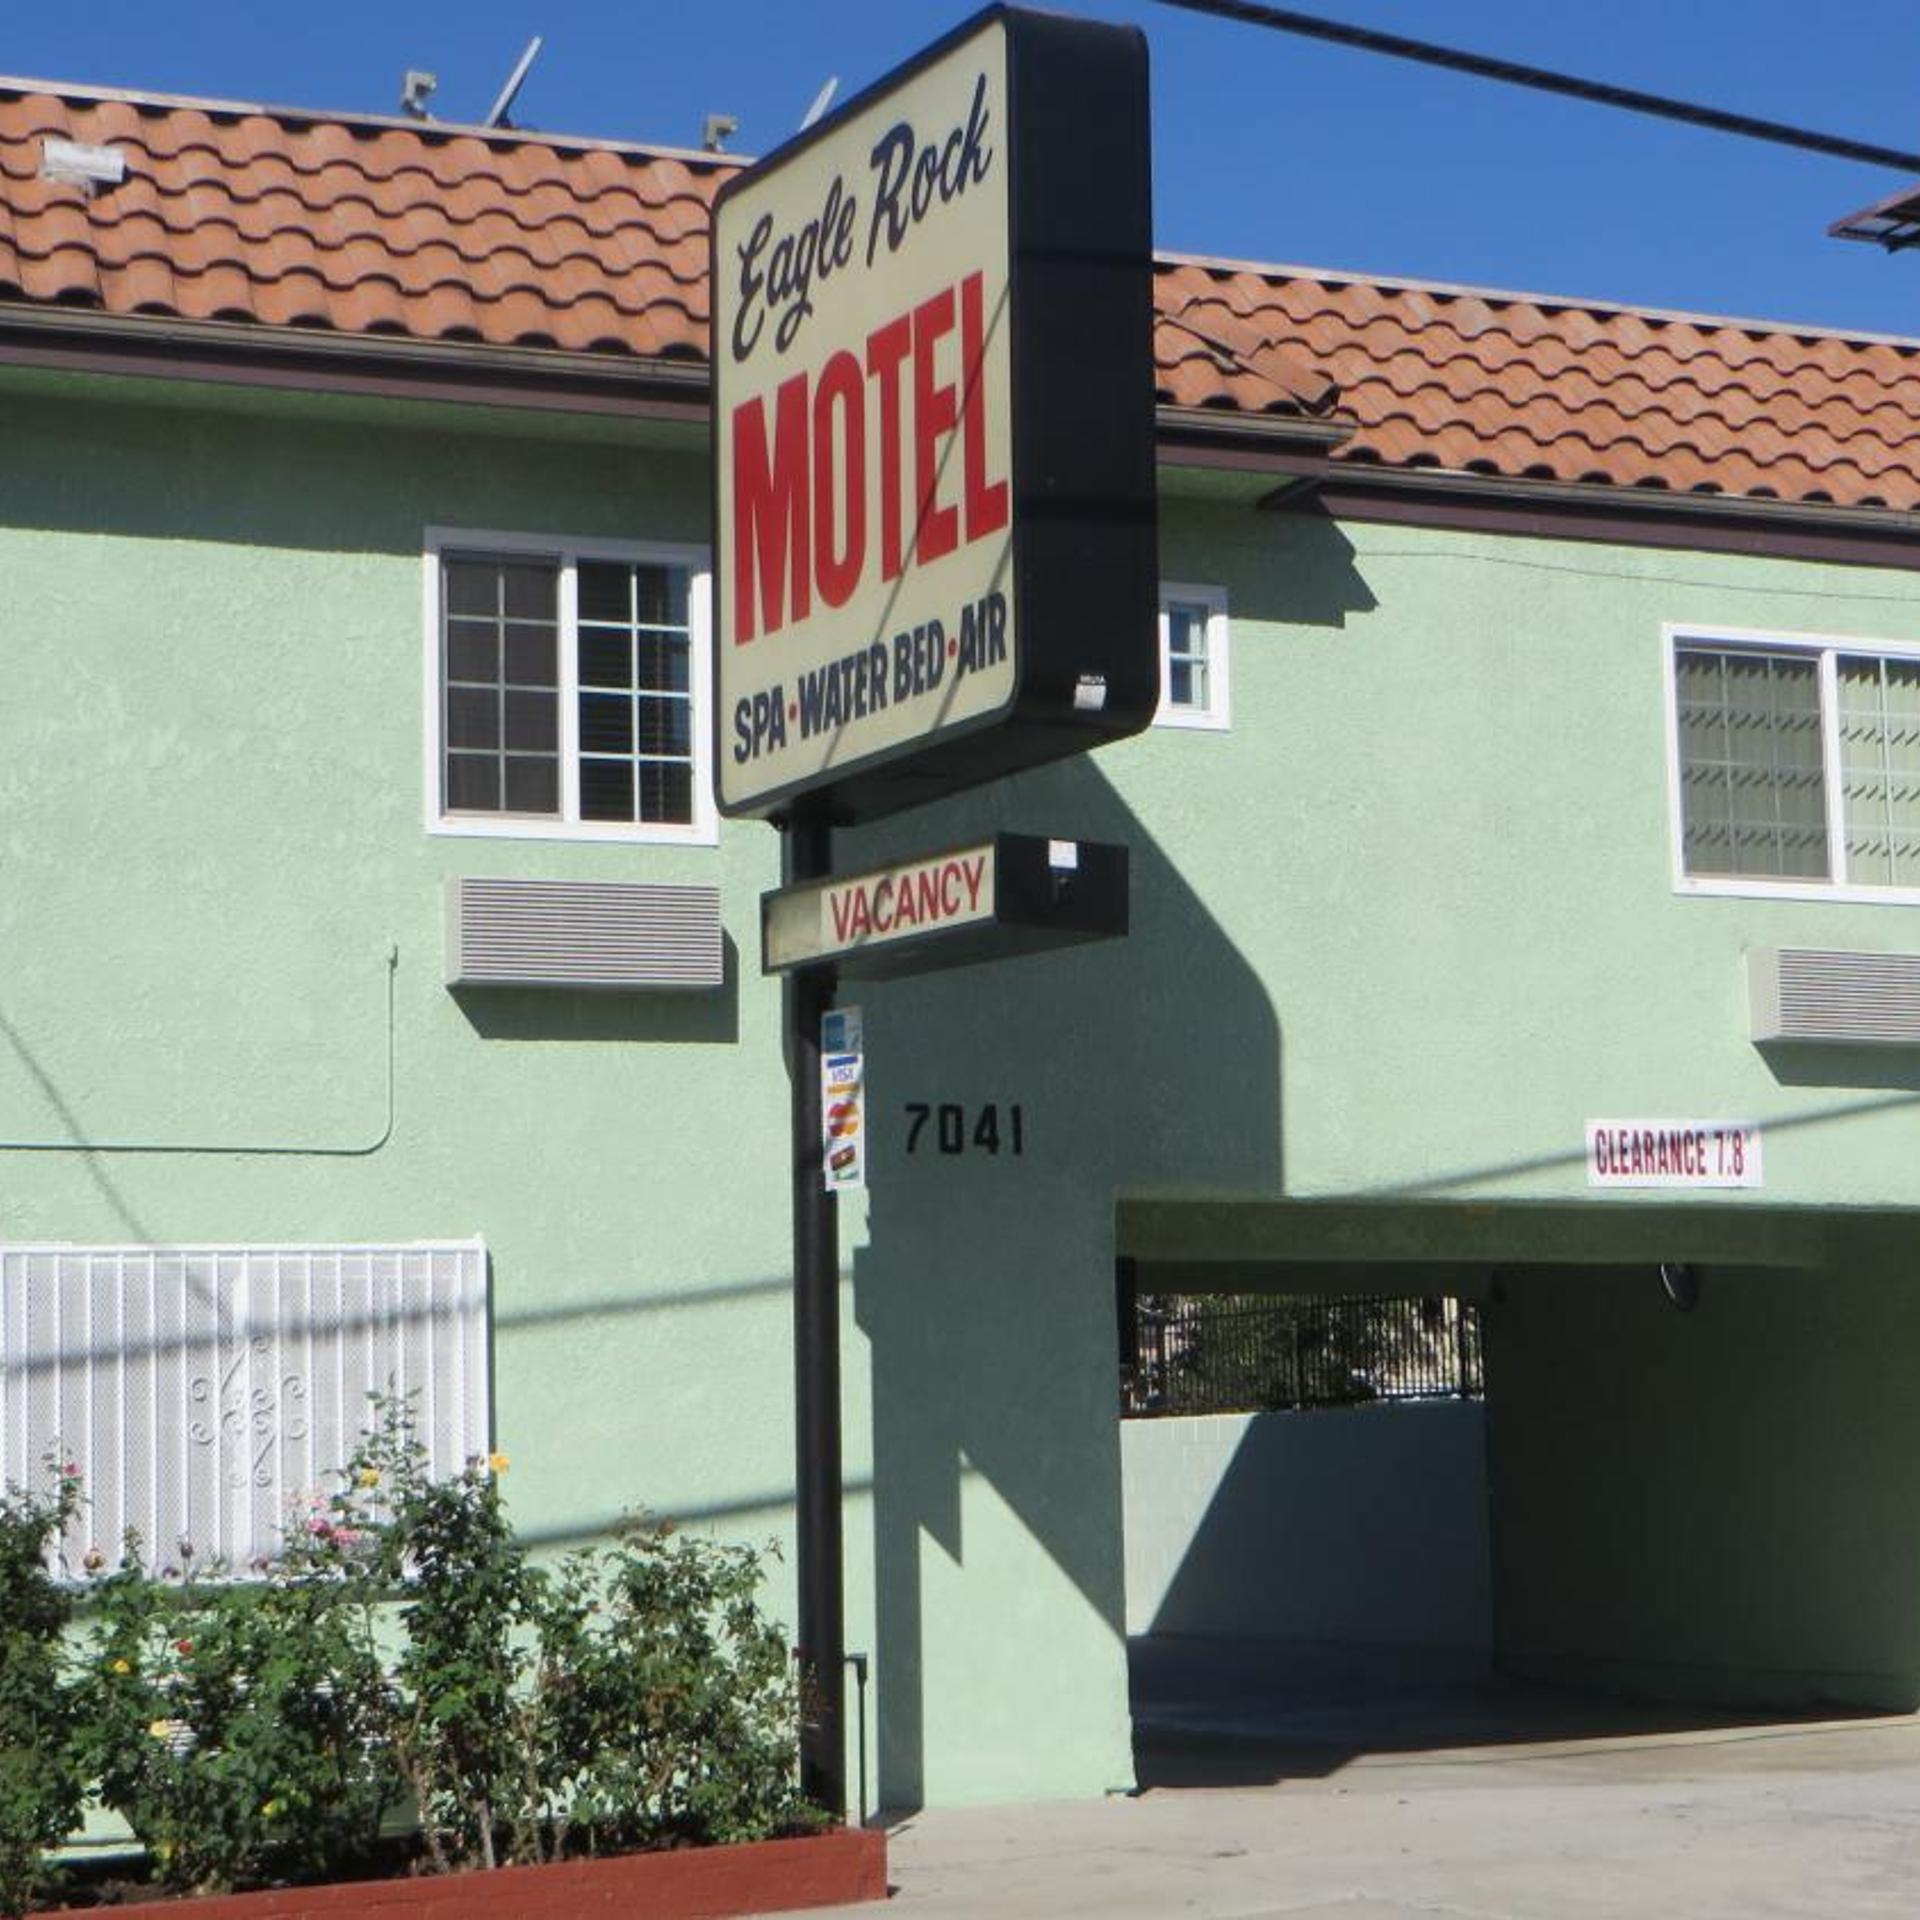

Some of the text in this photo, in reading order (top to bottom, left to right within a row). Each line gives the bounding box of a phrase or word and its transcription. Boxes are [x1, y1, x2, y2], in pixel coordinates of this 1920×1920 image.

[733, 73, 992, 362] Eagle Rock
[733, 270, 1008, 646] MOTEL
[734, 592, 1007, 764] SPA WATER BED AIR
[831, 856, 985, 943] VACANCY
[905, 1104, 1023, 1154] 7041
[1595, 1129, 1706, 1175] CLEARANCE
